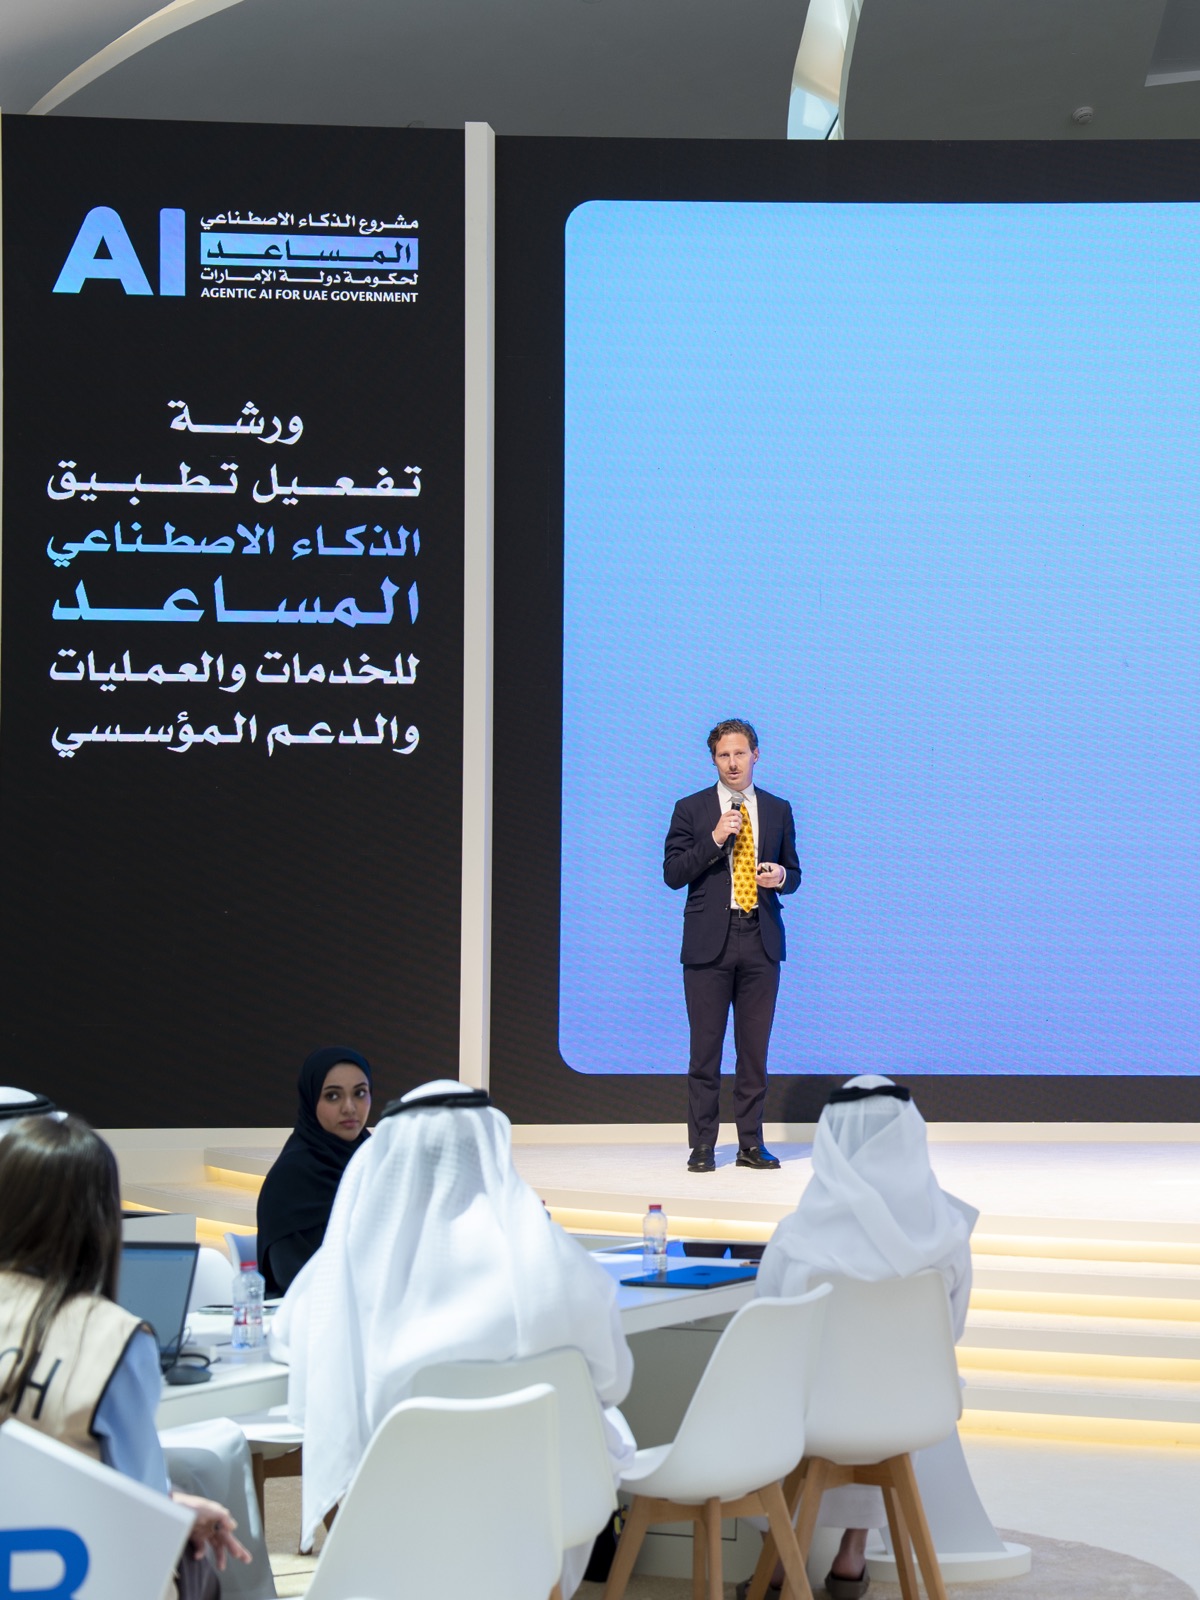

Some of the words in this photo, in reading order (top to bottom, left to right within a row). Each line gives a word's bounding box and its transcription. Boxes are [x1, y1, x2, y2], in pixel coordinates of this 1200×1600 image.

[199, 210, 295, 231] الاصطناعي
[298, 213, 356, 229] الذكاء
[358, 213, 419, 235] مشروع
[52, 205, 186, 297] AI
[206, 239, 412, 265] المساعد
[199, 267, 277, 285] الإمارات
[200, 287, 257, 299] AGENTIC
[258, 288, 273, 300] AI
[275, 289, 301, 300] FOR
[303, 289, 328, 301] UAE
[330, 290, 419, 303] GOVERNMENT
[278, 269, 341, 287] دولة
[342, 271, 419, 288] لحكومة
[167, 399, 304, 445] ورشة
[46, 459, 239, 507] تطبيق
[252, 463, 423, 506] تفعيل
[46, 520, 275, 568] الاصطناعي
[291, 523, 421, 561] الذكاء
[51, 574, 420, 629] المساعد
[49, 648, 247, 693] والعمليات
[255, 651, 421, 685] للخدمات
[51, 710, 258, 759] المؤسسي
[266, 712, 420, 757] والدعم
